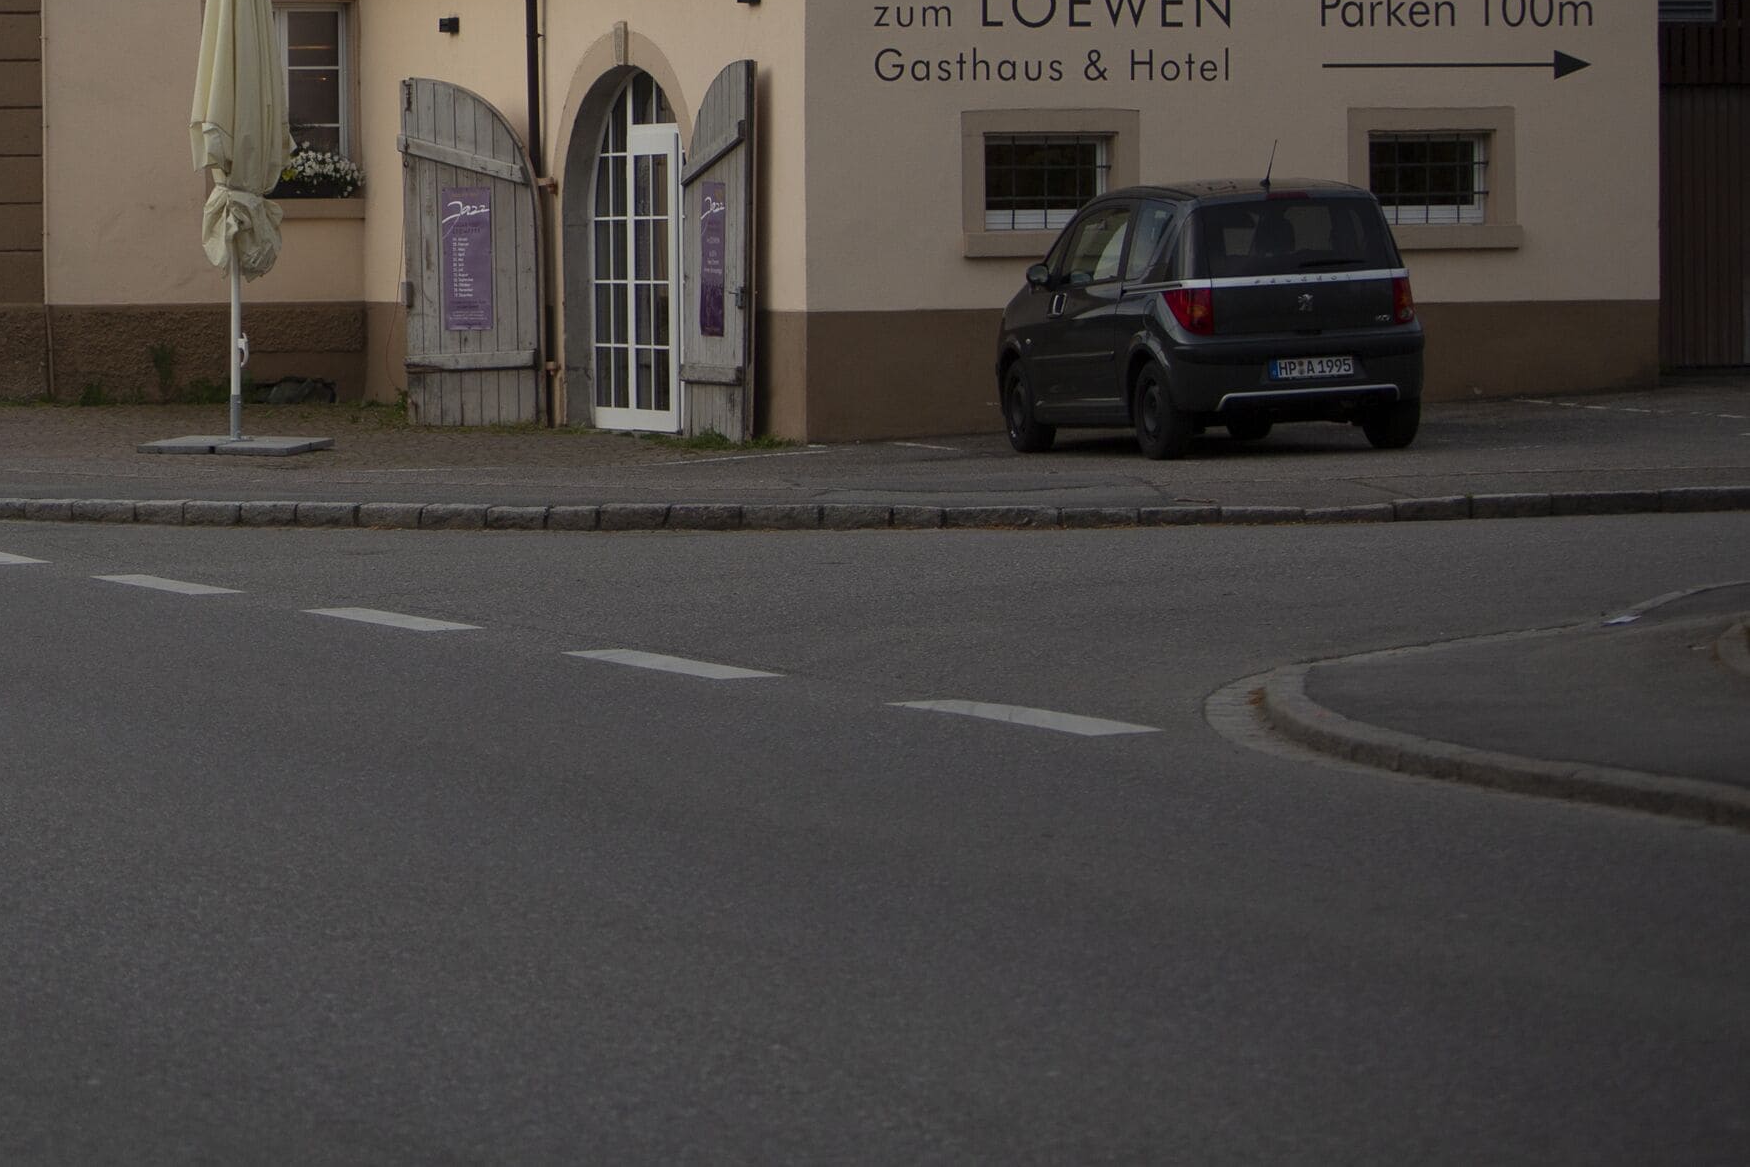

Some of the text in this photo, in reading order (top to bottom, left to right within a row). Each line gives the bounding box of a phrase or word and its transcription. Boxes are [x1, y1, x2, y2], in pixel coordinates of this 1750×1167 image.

[873, 5, 952, 28] zum
[874, 46, 1229, 82] Gasthaus & Hotel
[441, 200, 490, 225] Jazz
[1278, 358, 1352, 376] HP A 1995
